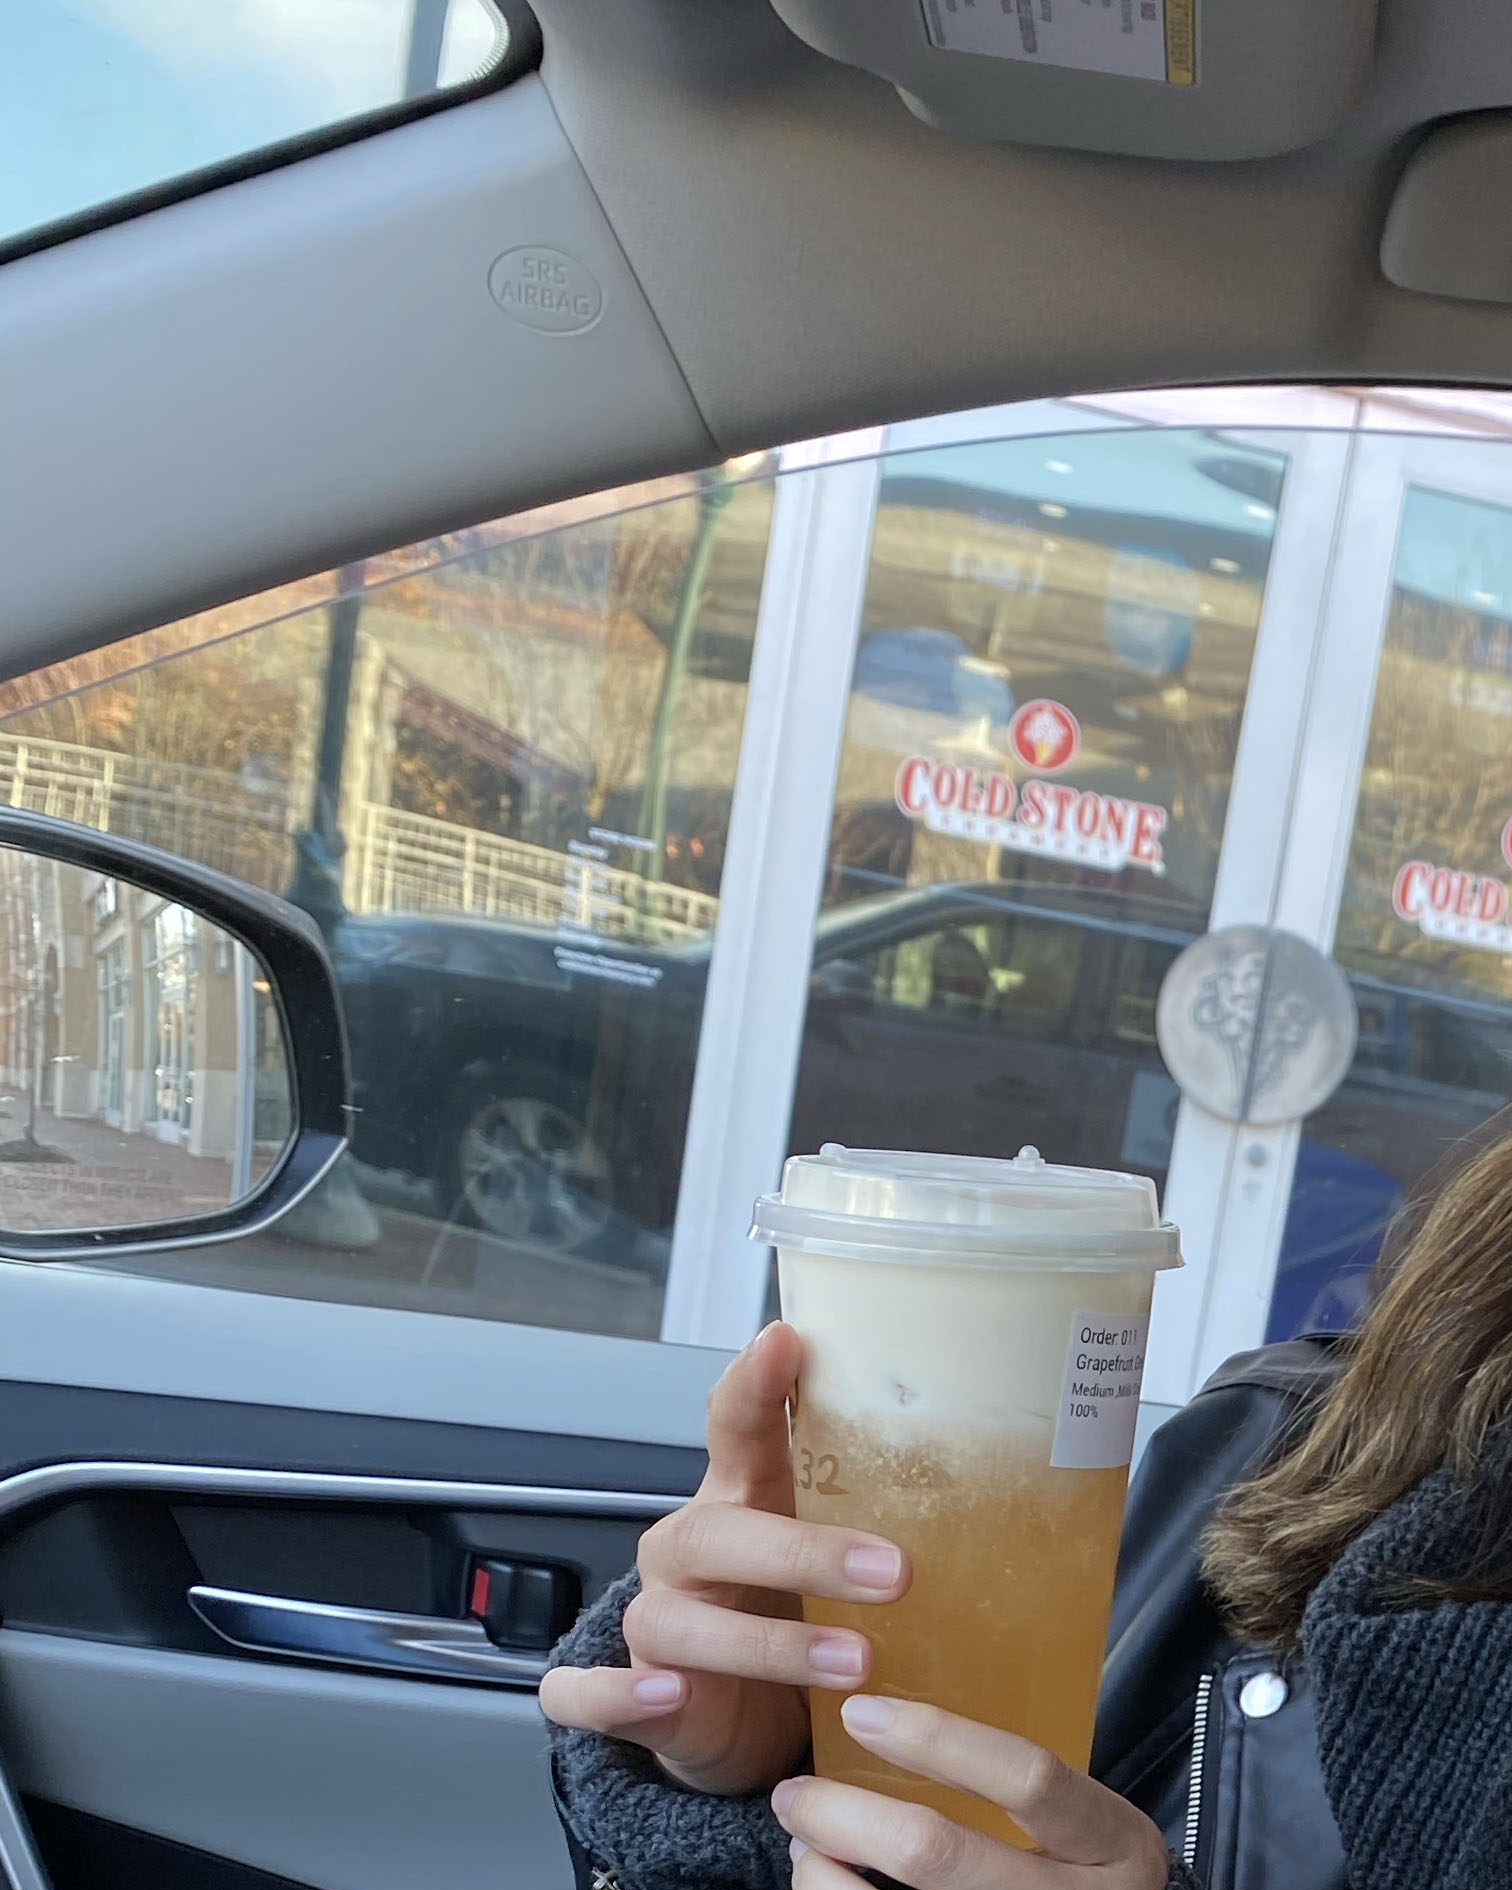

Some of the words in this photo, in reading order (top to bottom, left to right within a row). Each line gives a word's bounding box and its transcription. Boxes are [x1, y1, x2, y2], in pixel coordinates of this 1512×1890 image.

[521, 257, 567, 285] SRS
[500, 280, 590, 316] AIRBAG
[899, 756, 1014, 818] COLD
[1018, 781, 1165, 862] STONE
[1396, 862, 1505, 921] COLD
[1071, 1383, 1114, 1397] Medium
[1069, 1403, 1098, 1418] 100%
